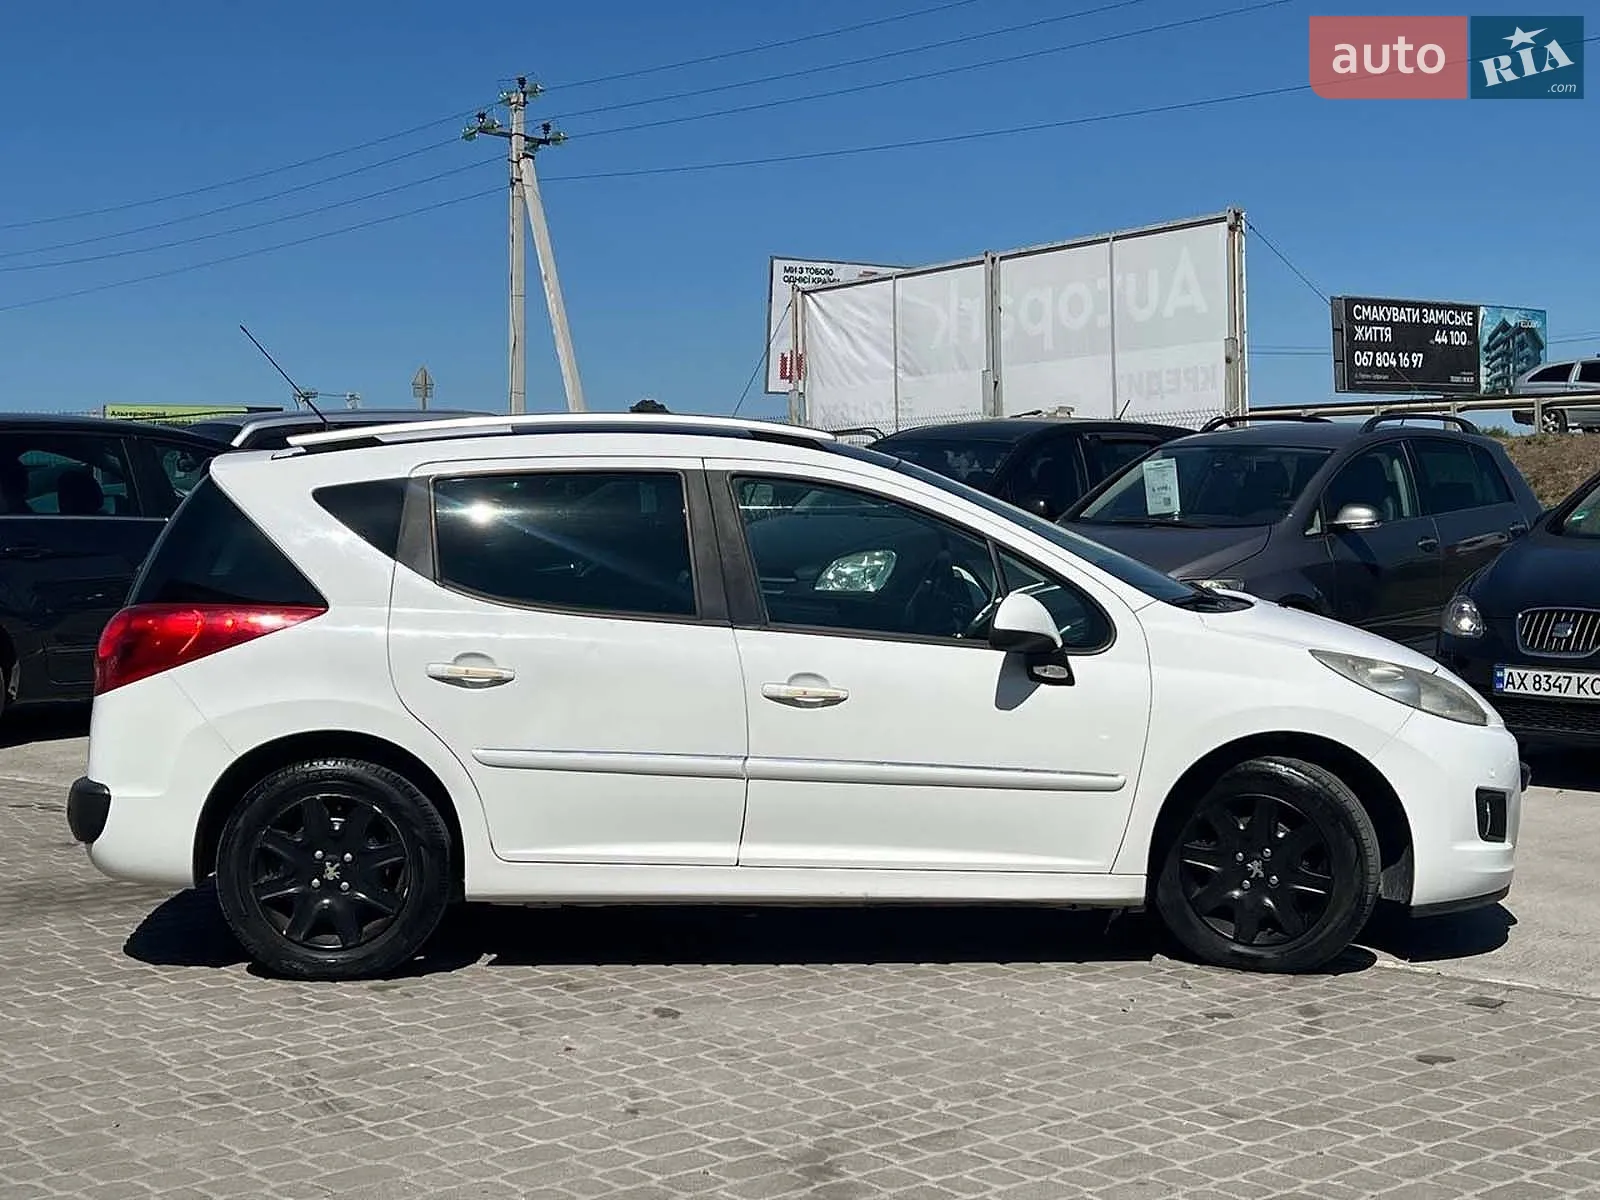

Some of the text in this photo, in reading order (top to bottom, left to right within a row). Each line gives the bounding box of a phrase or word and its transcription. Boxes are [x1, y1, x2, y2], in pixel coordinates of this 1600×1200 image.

[784, 266, 797, 274] МИ
[805, 267, 834, 276] ТОБОЮ
[1353, 304, 1474, 327] СМАКУВАТИ ЗАМІСЬКЕ
[1353, 325, 1392, 342] ЖИТТЯ
[1434, 330, 1467, 346] 44 100
[1354, 350, 1424, 369] 067 804 16 97
[1505, 672, 1528, 691] AX
[1532, 673, 1573, 694] 8347
